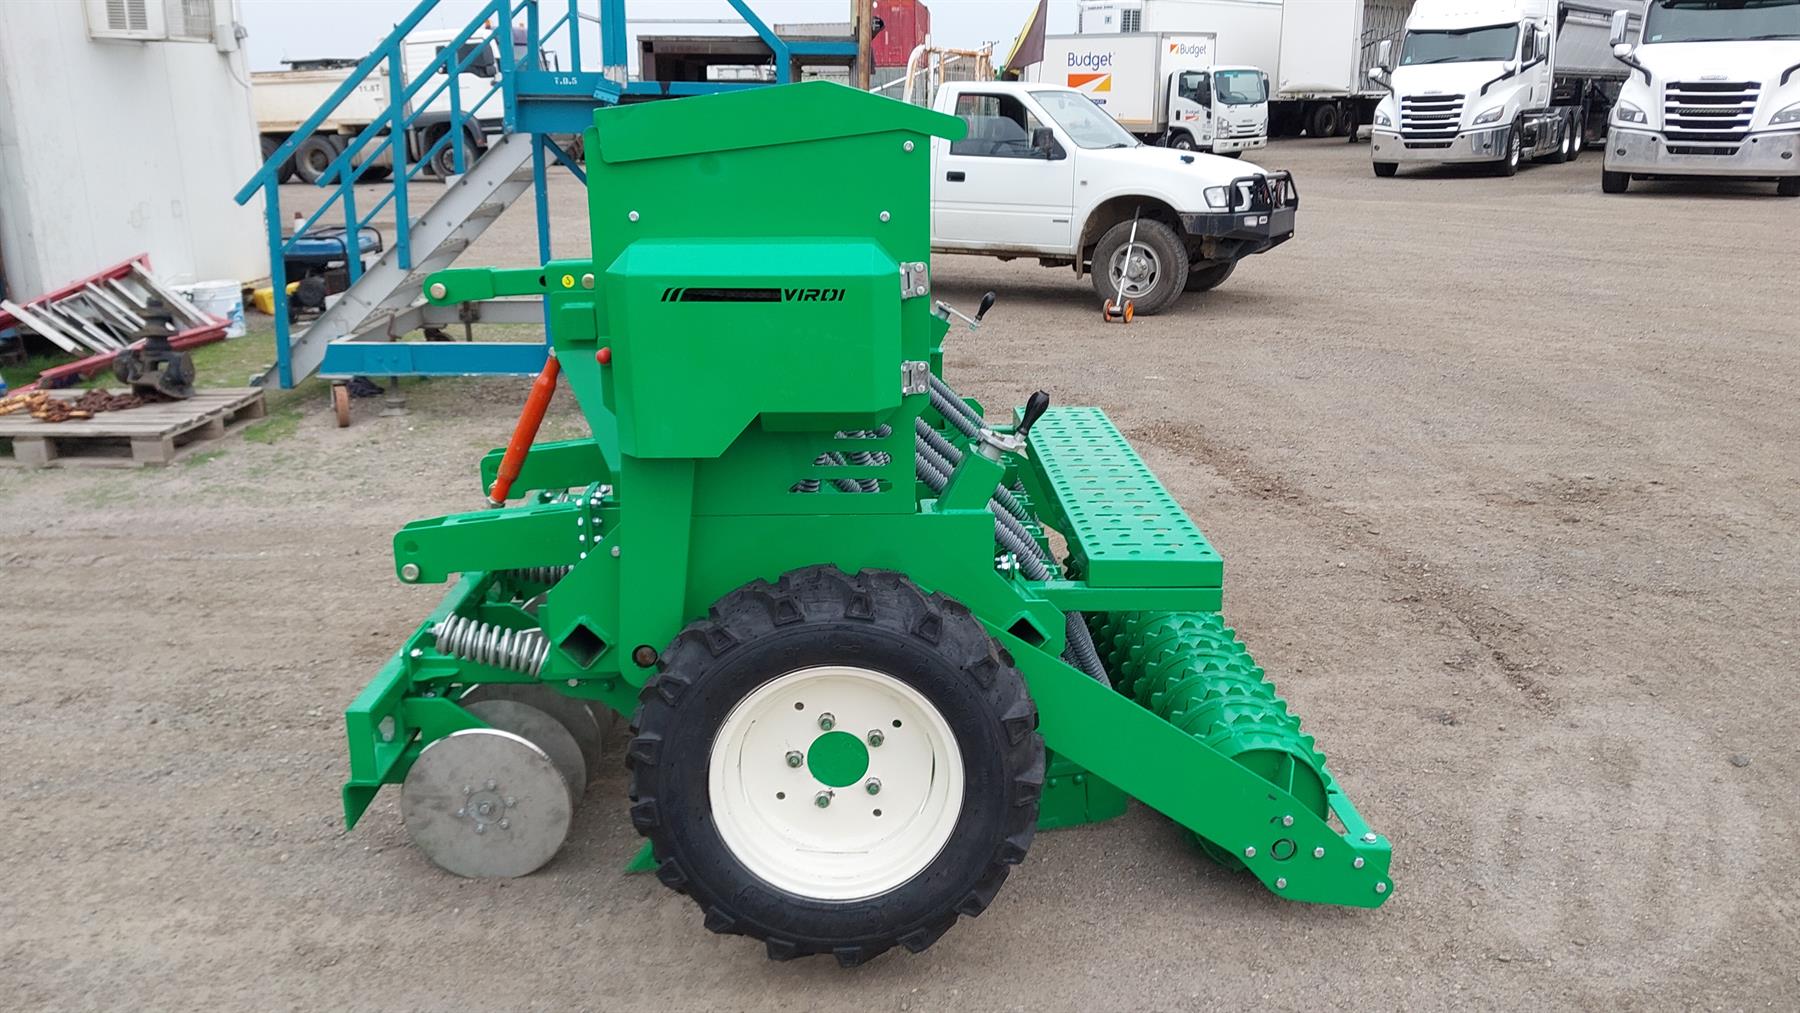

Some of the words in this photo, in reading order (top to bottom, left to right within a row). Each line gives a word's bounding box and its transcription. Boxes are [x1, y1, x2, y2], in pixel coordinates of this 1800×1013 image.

[1180, 43, 1207, 58] Budget
[1067, 51, 1112, 71] Budget
[784, 288, 846, 302] VIRDI
